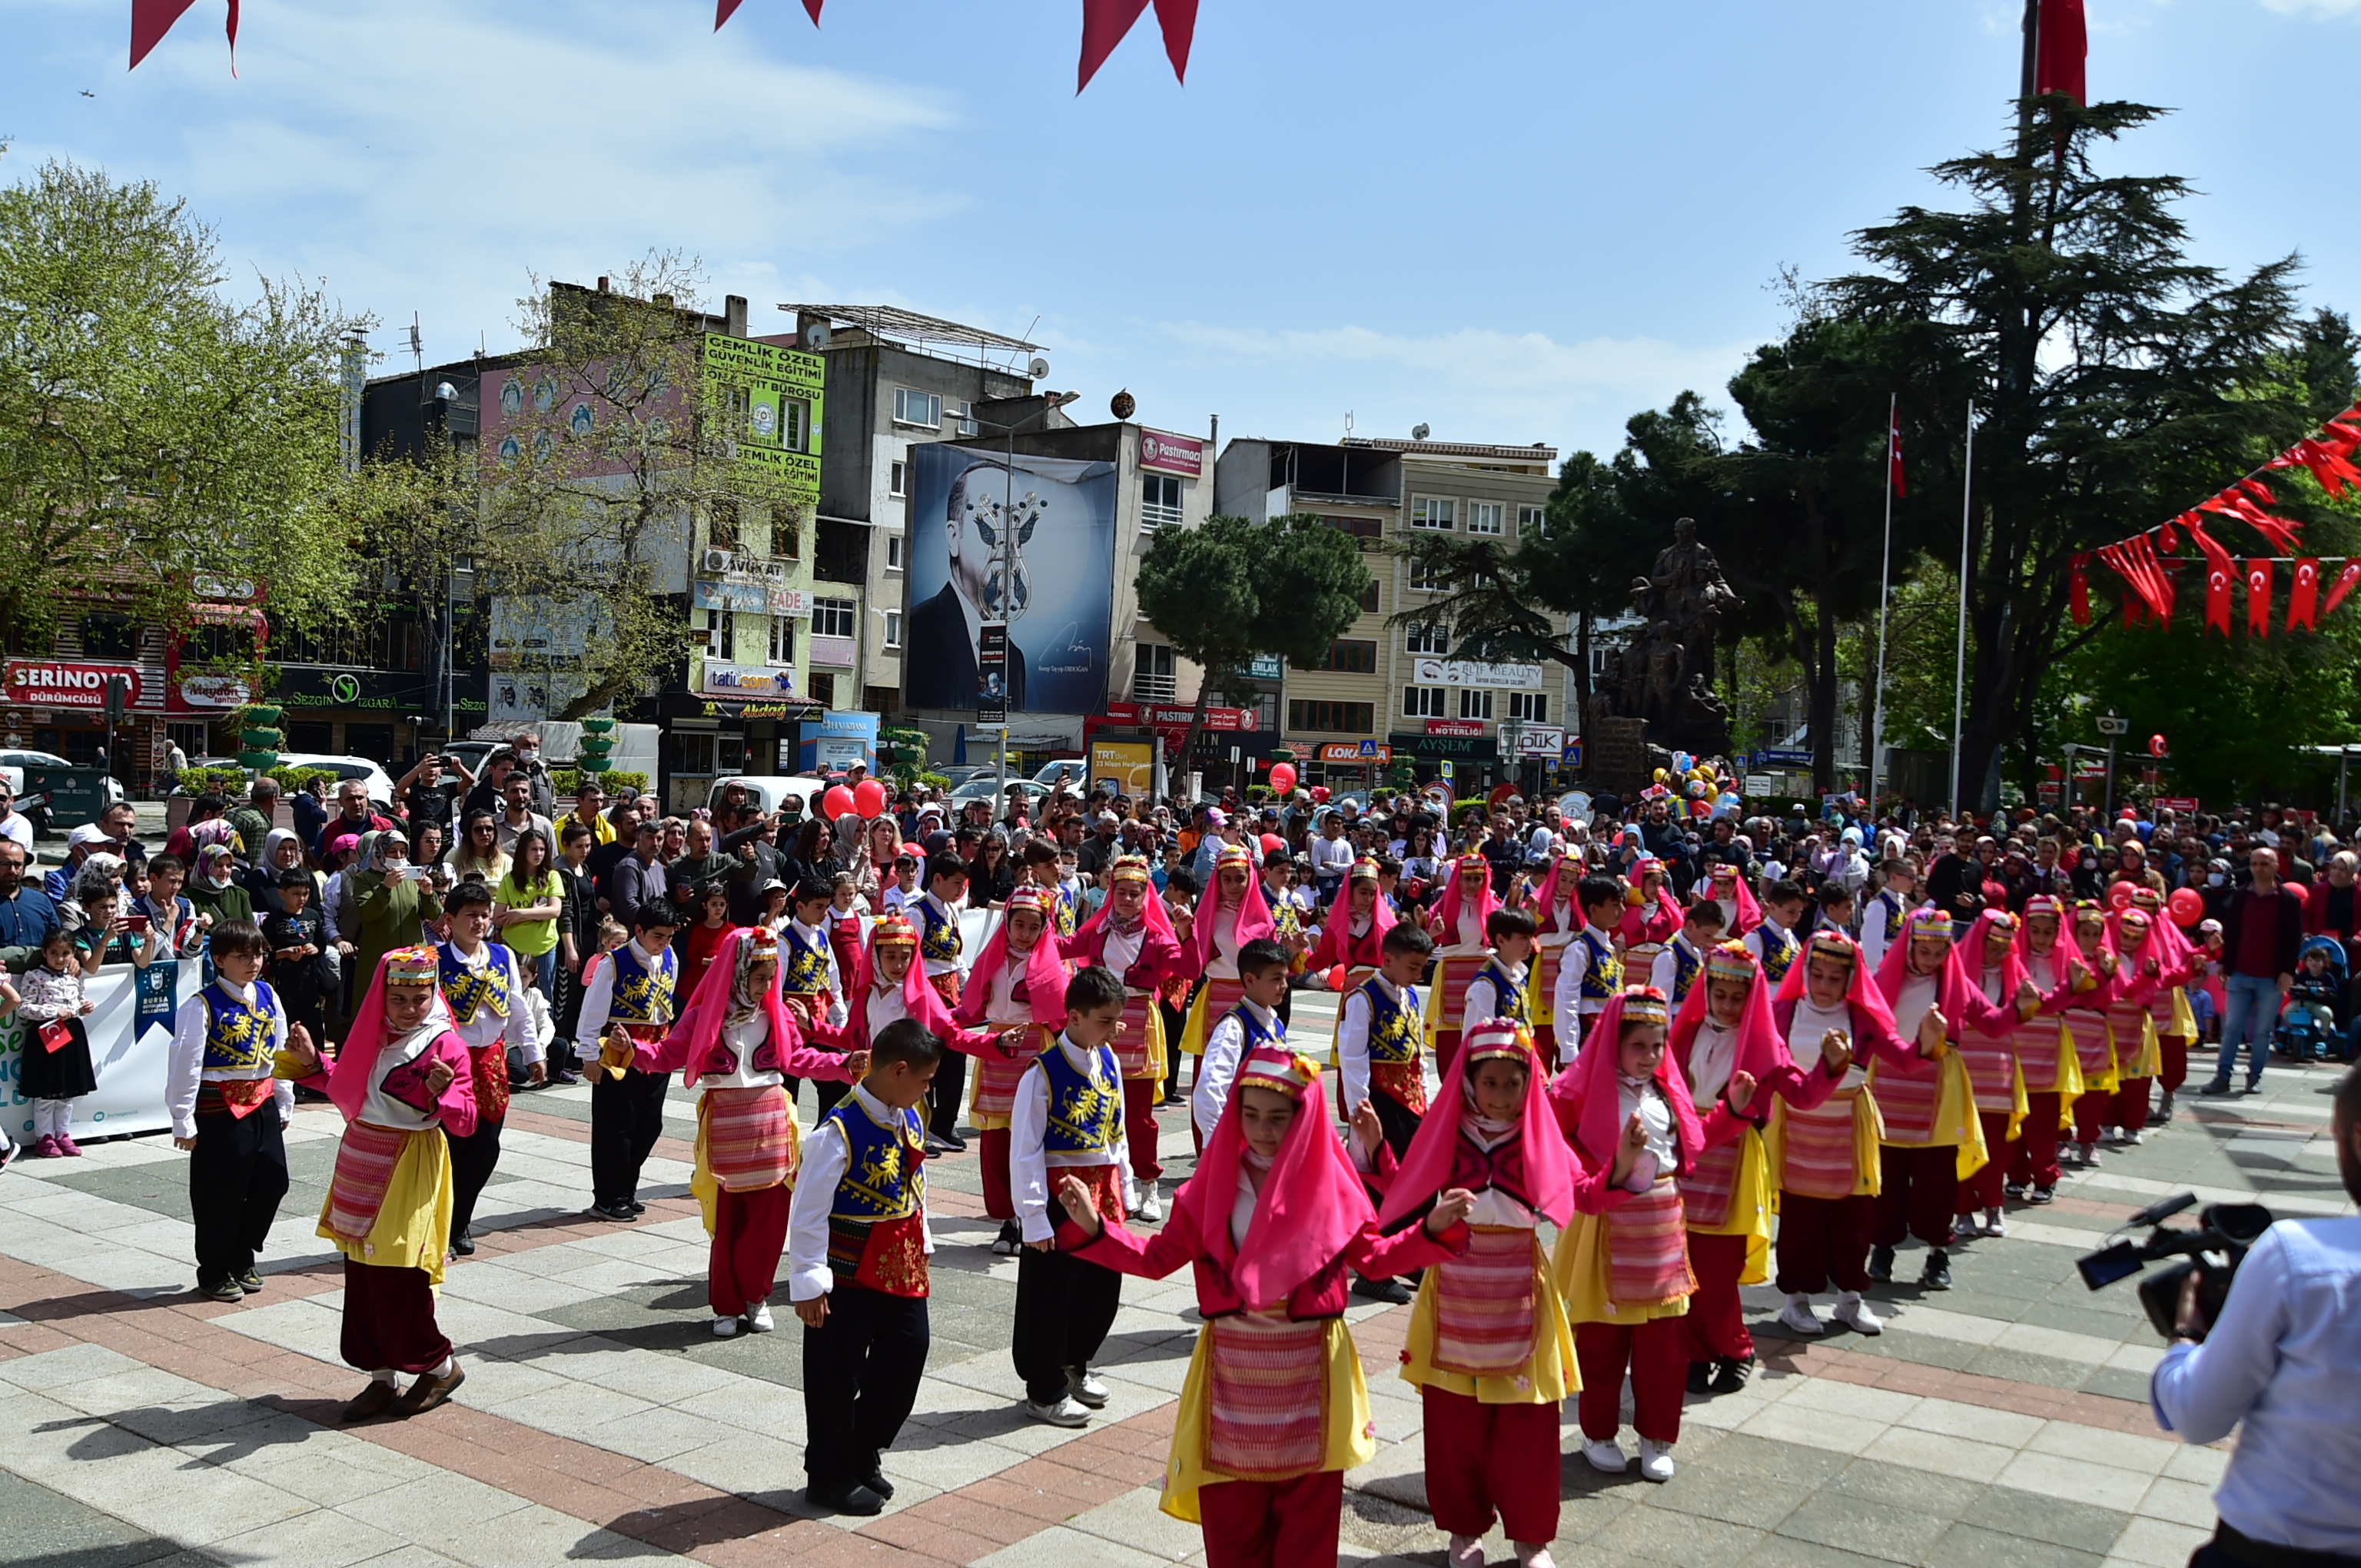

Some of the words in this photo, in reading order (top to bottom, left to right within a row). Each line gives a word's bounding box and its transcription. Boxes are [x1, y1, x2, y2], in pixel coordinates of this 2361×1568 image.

[709, 337, 773, 358] GEMLİK
[779, 350, 822, 368] ÖZEL
[709, 349, 773, 370] GÜVENLİK
[777, 364, 822, 380] EĞİTİMİ
[772, 383, 820, 400] BÜROSU
[736, 447, 782, 464] GEMLİK
[785, 454, 818, 470] ÖZEL
[1159, 443, 1201, 463] Pastırmacı
[784, 465, 818, 483] EĞİTİMİ
[1251, 662, 1279, 673] EMLAK
[1494, 666, 1541, 677] BEAUTY
[29, 690, 102, 705] DÜRÜMCÜSÜ
[358, 696, 398, 708] IZGARA
[739, 703, 787, 720] Akdağ
[1435, 727, 1482, 736] NOTERLİĞİ
[1418, 738, 1473, 753] AYŞEM
[1327, 746, 1386, 761] LOKAA
[143, 996, 168, 1005] BURSA
